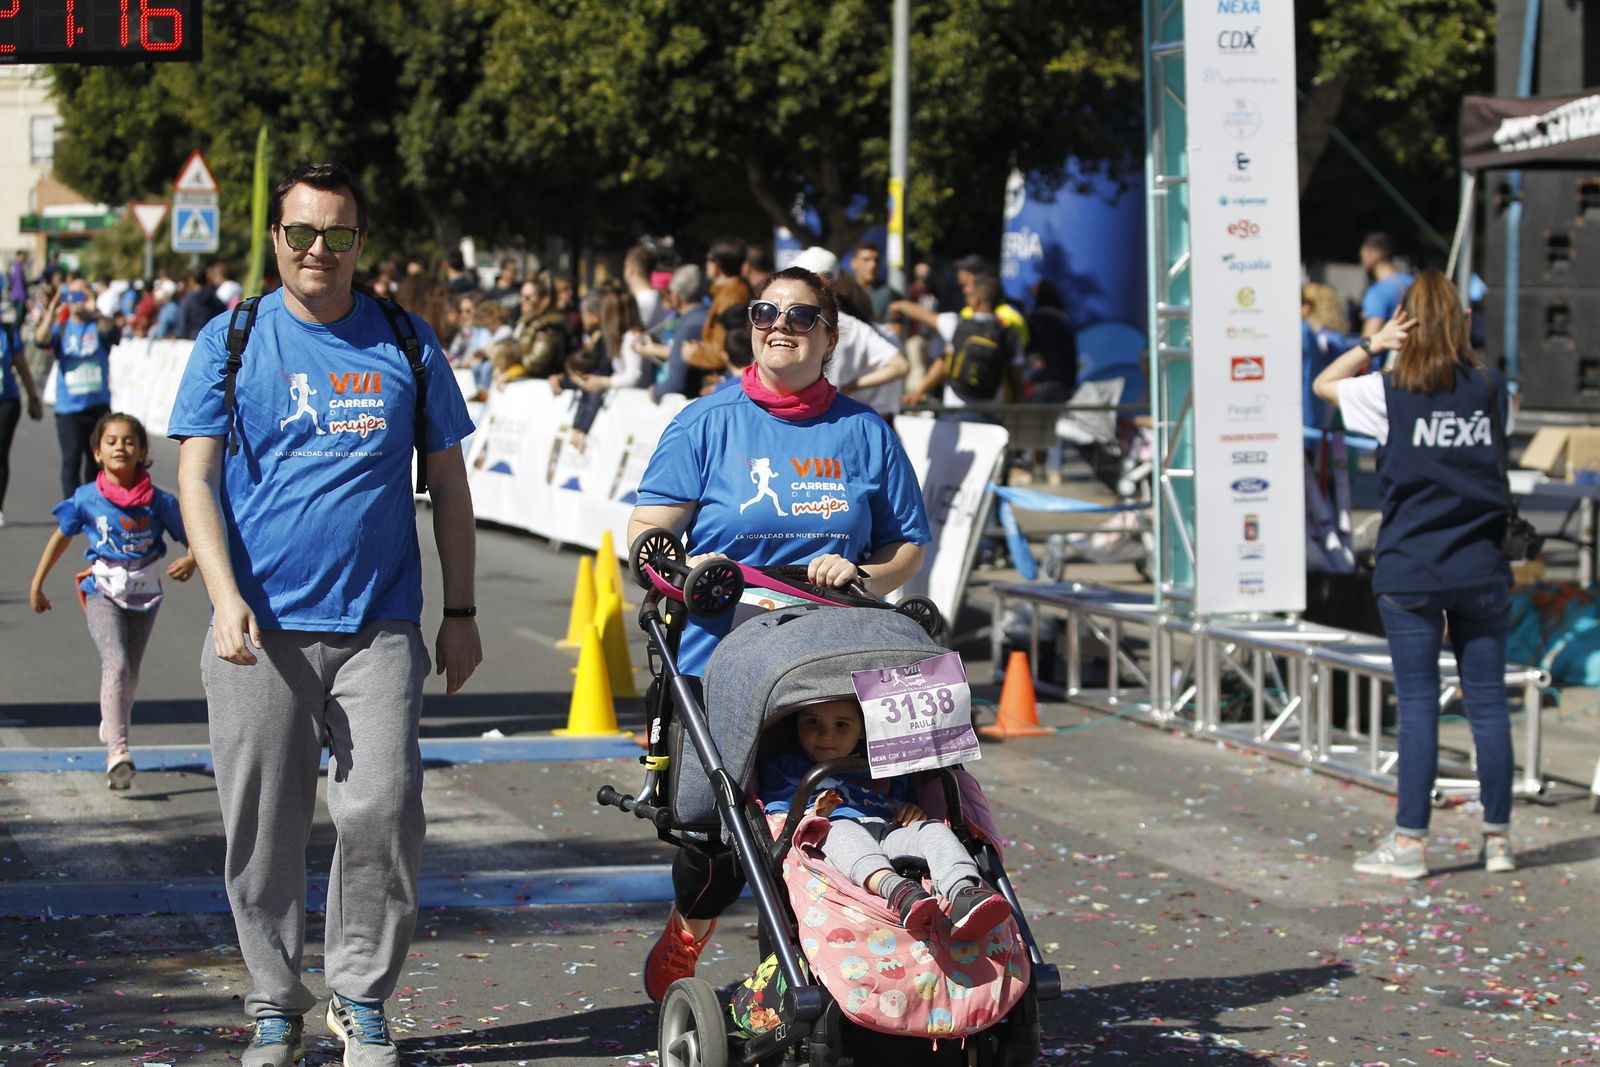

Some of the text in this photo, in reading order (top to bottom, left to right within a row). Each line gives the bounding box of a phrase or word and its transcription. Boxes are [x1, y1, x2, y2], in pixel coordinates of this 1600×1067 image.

[1217, 0, 1261, 14] NEXA
[1218, 29, 1257, 49] CDX
[328, 371, 382, 394] VIII
[329, 399, 384, 408] CARRERA
[790, 457, 842, 479] VIII
[791, 482, 846, 491] CARRERA
[880, 687, 955, 724] 3138
[909, 718, 937, 730] PAULA
